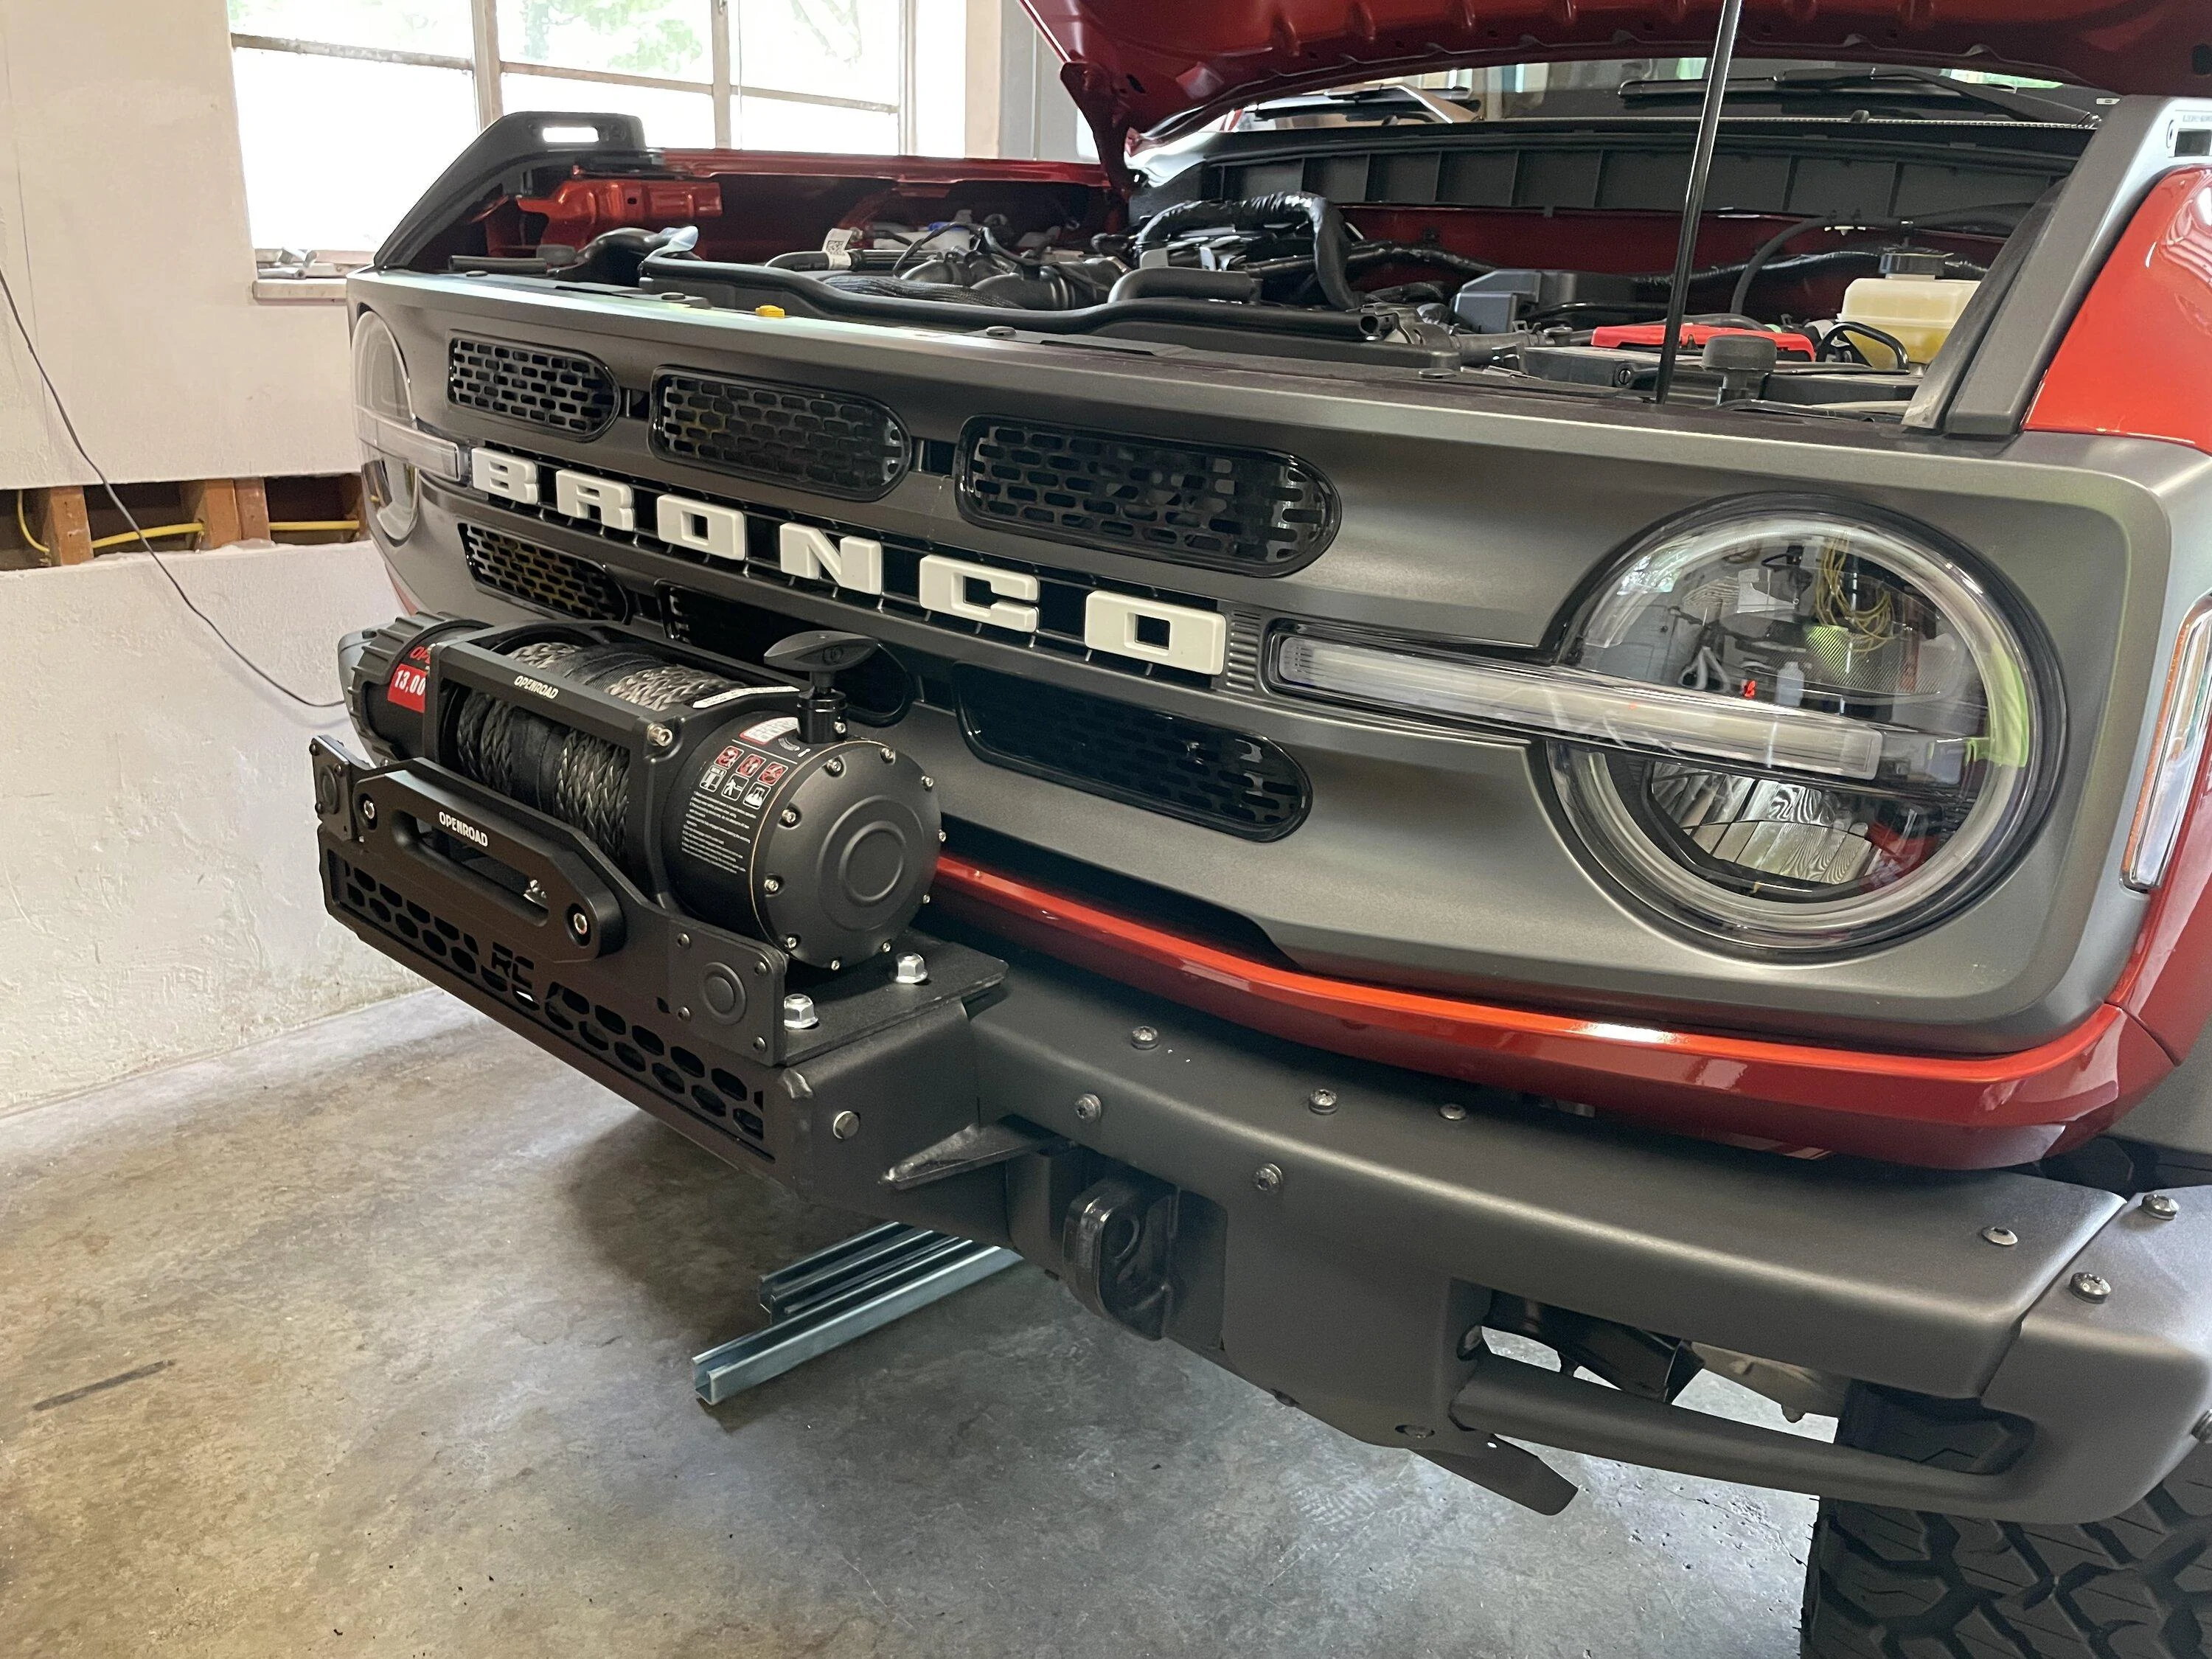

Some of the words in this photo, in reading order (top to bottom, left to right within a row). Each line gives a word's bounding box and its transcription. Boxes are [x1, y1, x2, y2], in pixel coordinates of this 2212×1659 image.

[471, 447, 1226, 675] BRONCO
[514, 675, 559, 699] OPENROAD
[439, 811, 488, 846] OPENROAD
